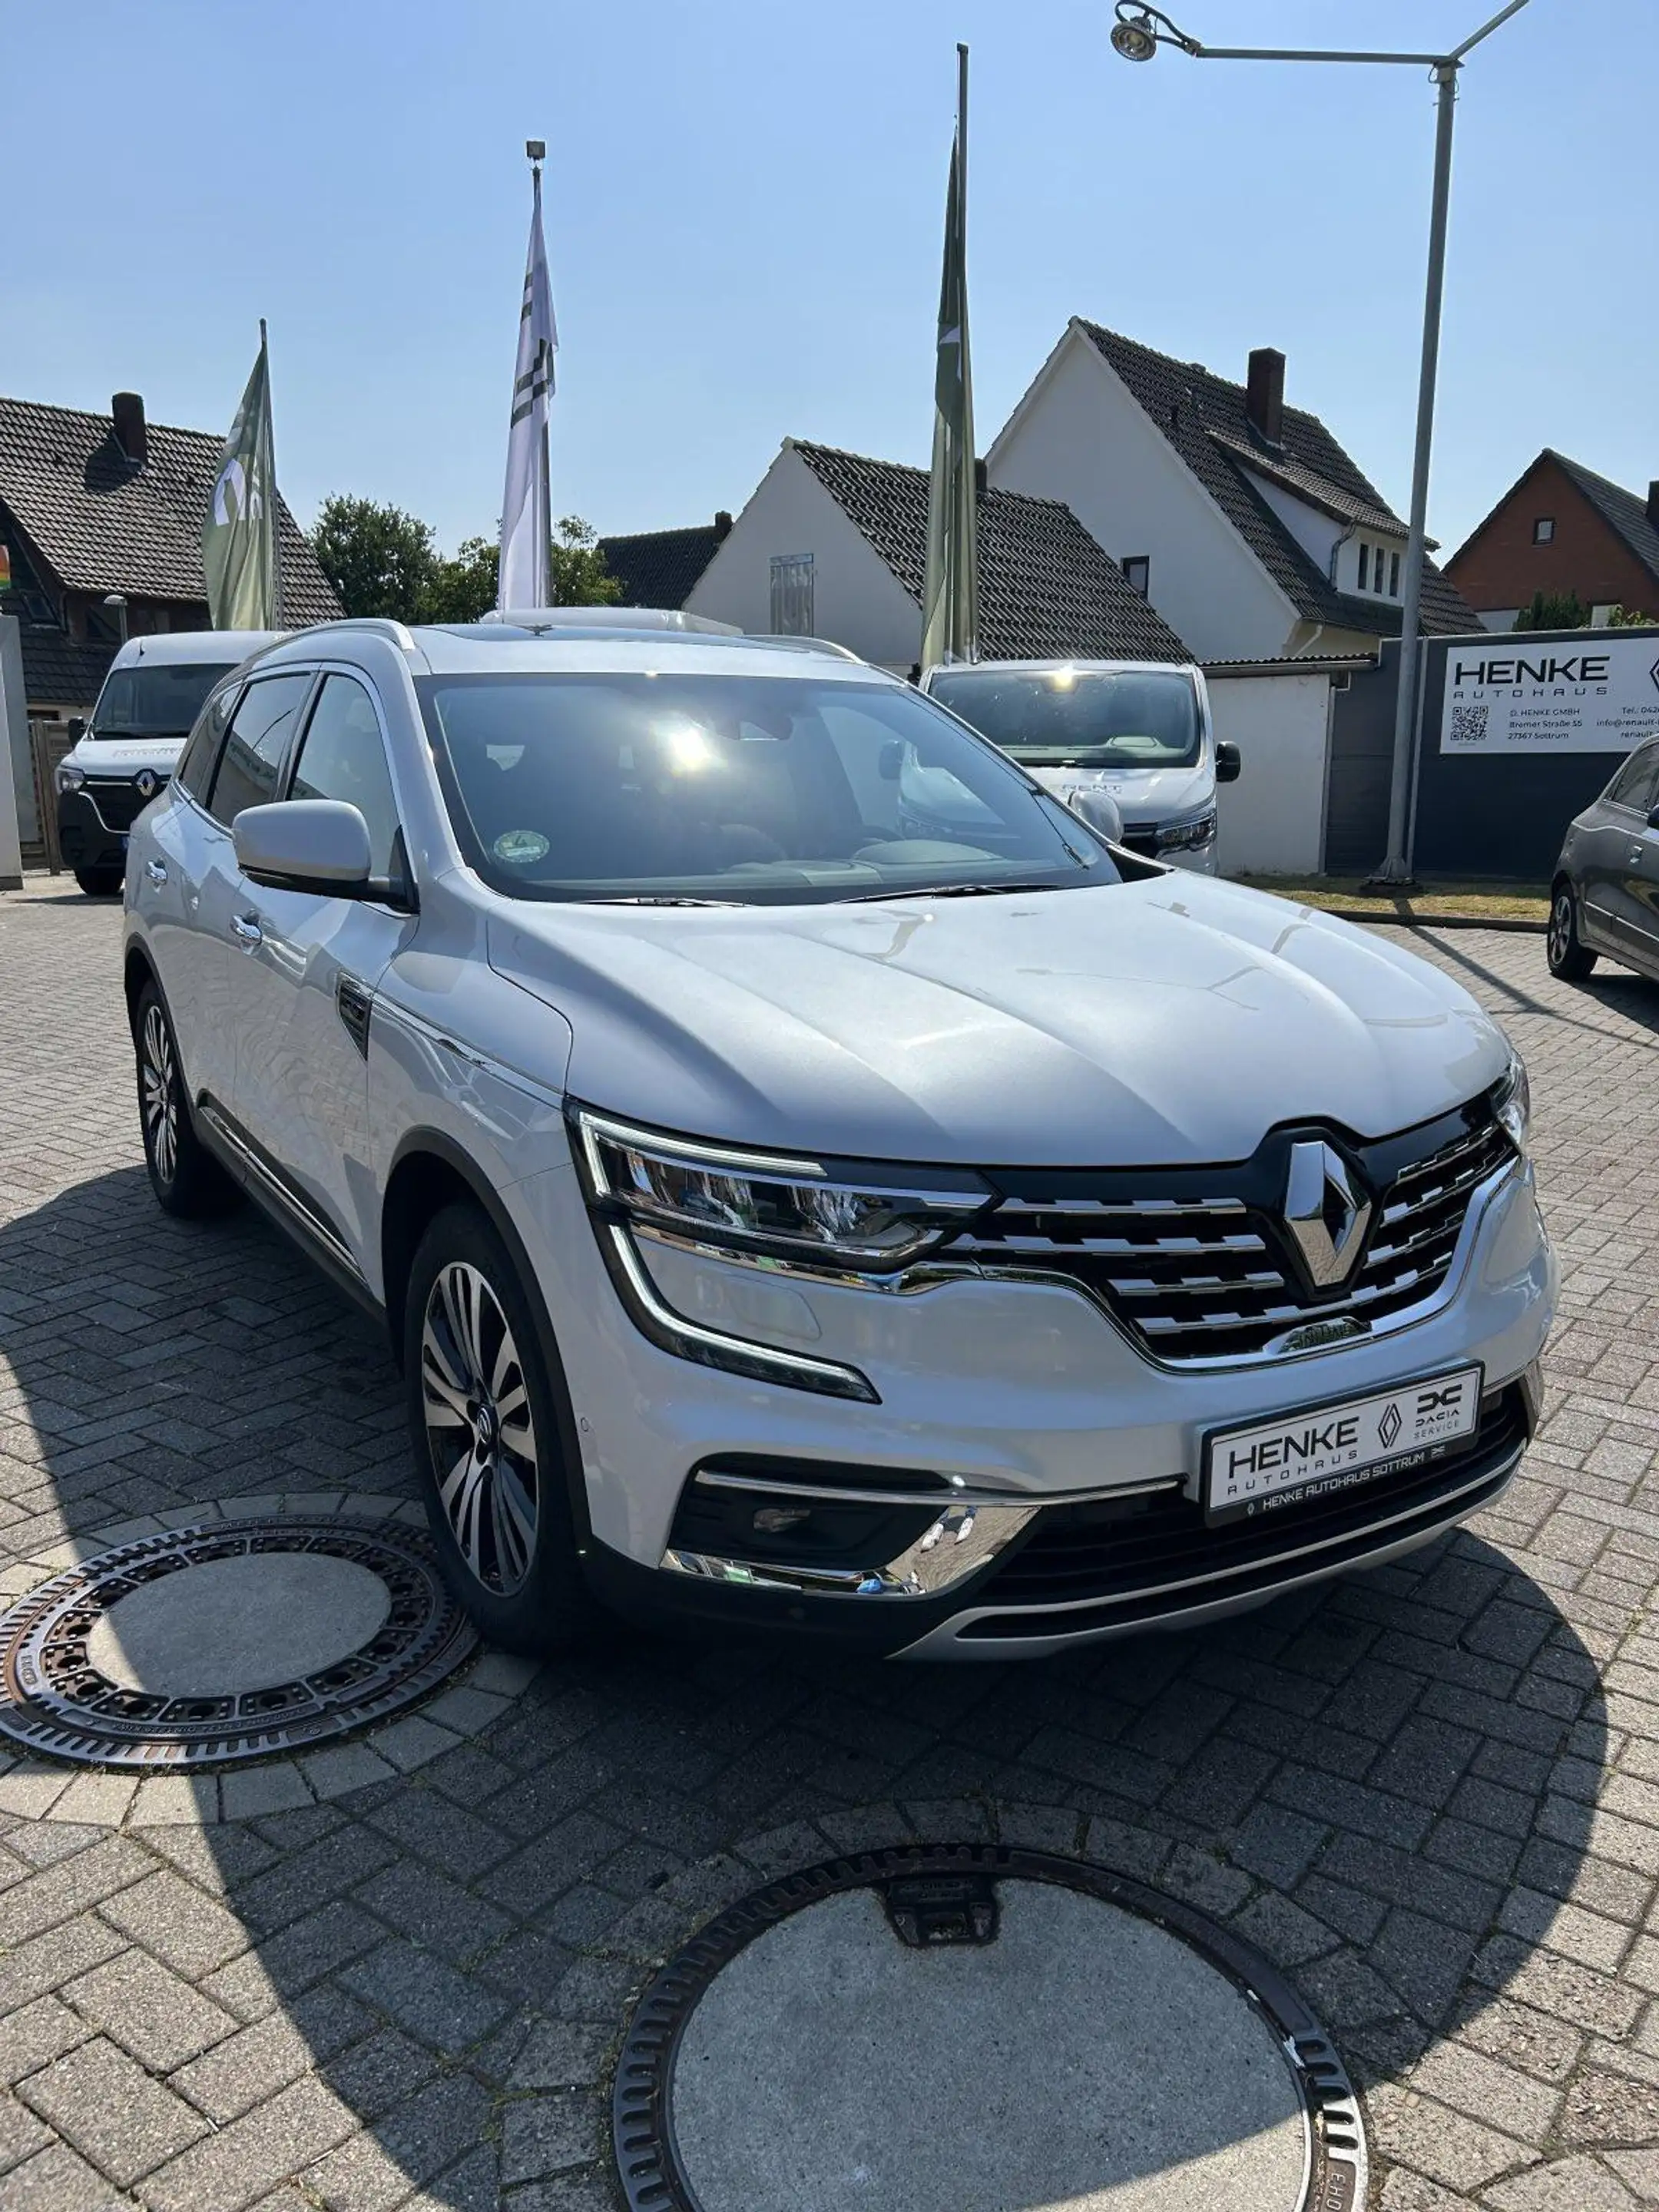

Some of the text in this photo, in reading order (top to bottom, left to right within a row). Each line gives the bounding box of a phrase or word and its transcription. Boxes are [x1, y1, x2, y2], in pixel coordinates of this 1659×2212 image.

[1455, 656, 1610, 685] HENKE
[1453, 687, 1608, 699] AUTOHAUS
[1521, 708, 1551, 717] HENKE
[1414, 1419, 1459, 1439] SERVICE
[1416, 1408, 1460, 1428] DACIA
[1229, 1416, 1359, 1479] HENKE
[1227, 1449, 1358, 1495] AUTOHAUS
[1263, 1451, 1425, 1511] HENKE AUTOHAUS SOTTRUM
